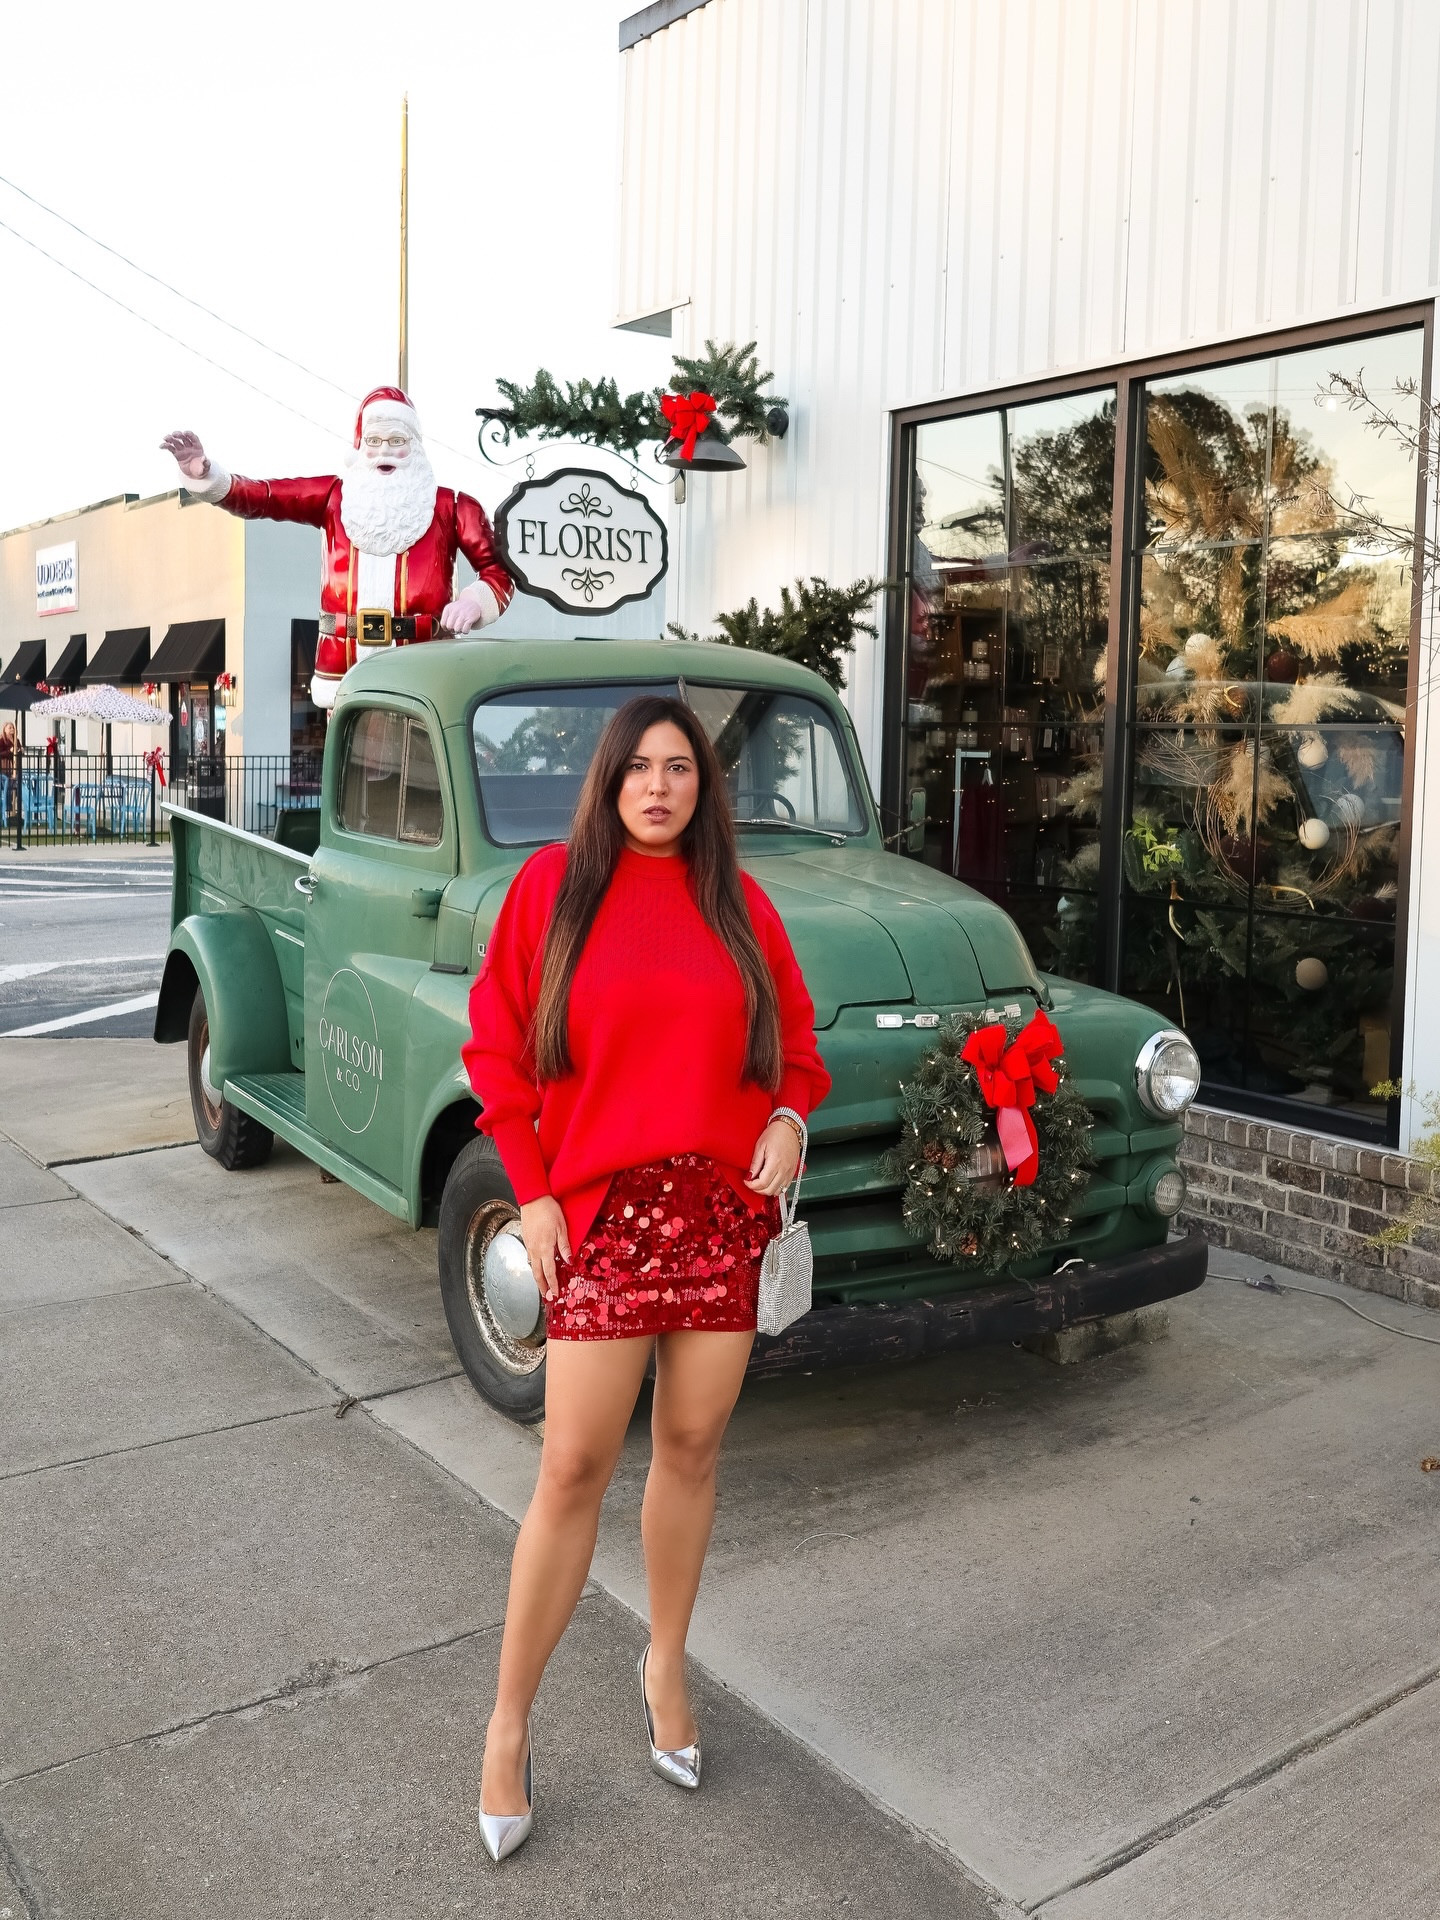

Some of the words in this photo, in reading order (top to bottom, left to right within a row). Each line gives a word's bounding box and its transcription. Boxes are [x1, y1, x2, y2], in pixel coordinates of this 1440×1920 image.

[517, 518, 653, 564] FLORIST
[319, 1017, 383, 1081] CARLSON
[336, 1067, 343, 1082] &
